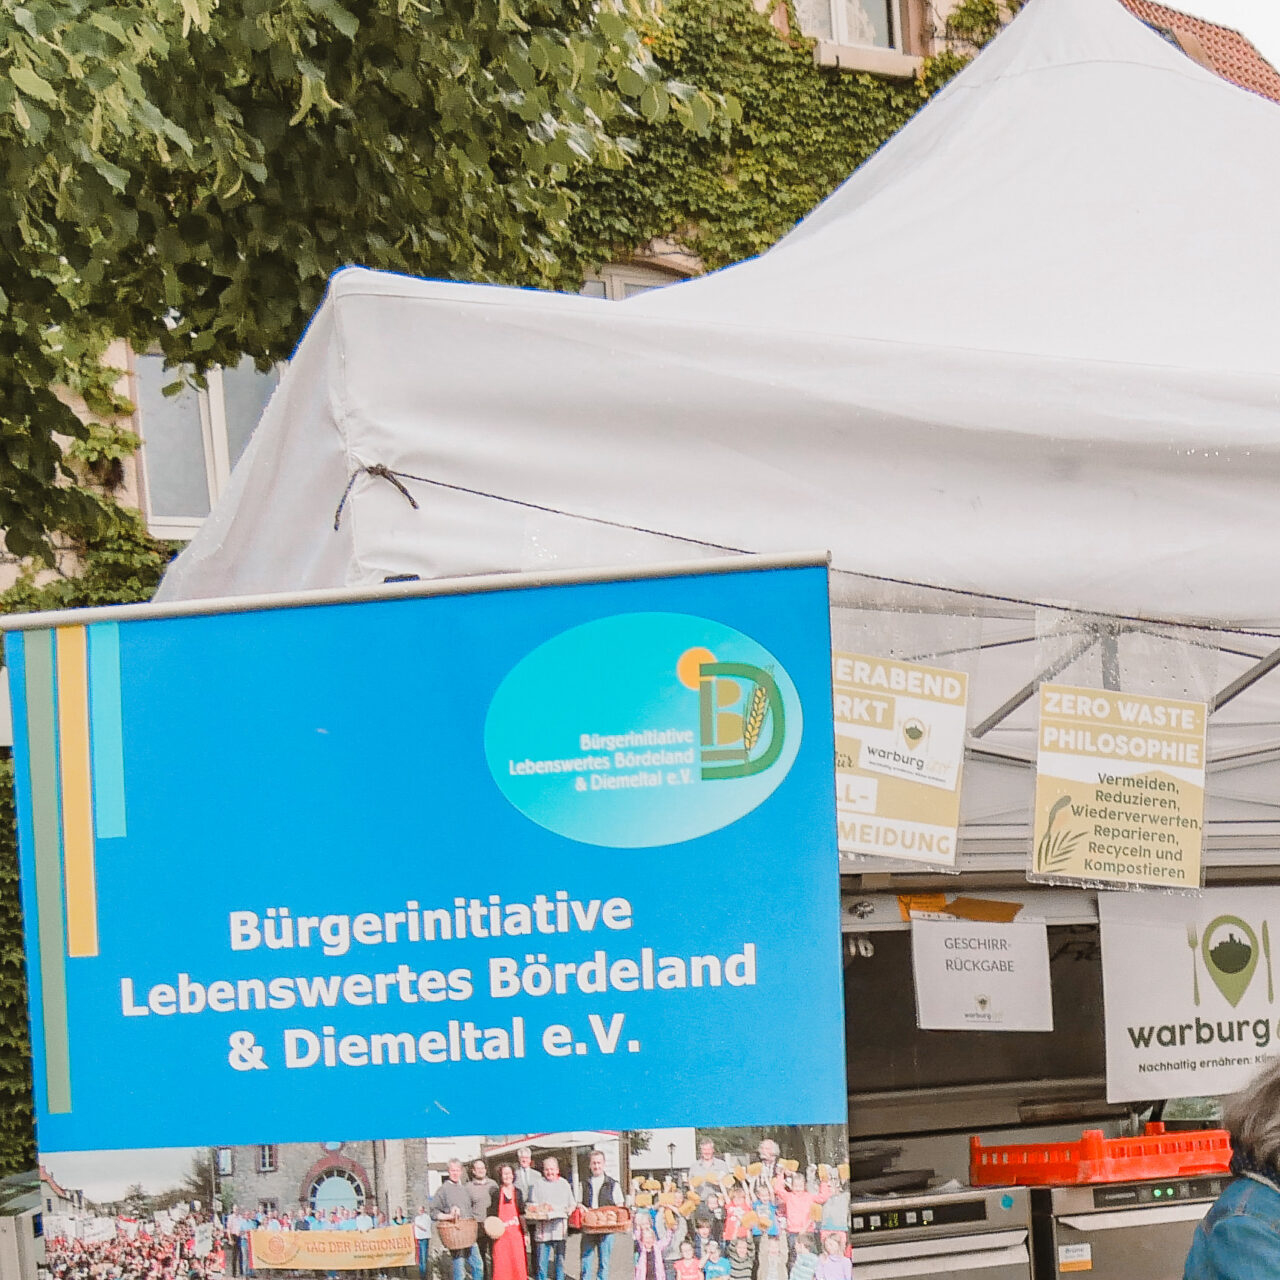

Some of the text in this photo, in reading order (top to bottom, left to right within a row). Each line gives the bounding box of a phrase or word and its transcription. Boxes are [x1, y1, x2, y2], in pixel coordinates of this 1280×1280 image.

[836, 658, 961, 700] ERABEND
[835, 694, 888, 723] RKT
[1045, 691, 1111, 721] ZERO
[580, 729, 694, 751] Bürgerinitiative
[1043, 730, 1199, 764] PHILOSOPHIE
[509, 749, 695, 776] Lebenswertes Bördeland
[867, 746, 924, 770] warburg
[575, 768, 694, 792] & Diemeltal e.V.
[1097, 771, 1180, 794] Vermeiden,
[1096, 790, 1180, 811] Reduzieren,
[839, 821, 950, 854] MEIDUNG
[1094, 824, 1179, 845] Reparieren,
[1089, 842, 1182, 862] Recyceln und
[1084, 859, 1185, 879] Kompostieren
[229, 890, 633, 957] Bürgerinitiative
[945, 957, 1015, 973] RÜCKGABE
[120, 942, 757, 1017] Lebenswertes Bördeland
[227, 1012, 641, 1072] & Diemeltal e.V.
[1127, 1017, 1270, 1048] warburg
[1138, 1056, 1253, 1074] Nachhaltig ernähren:
